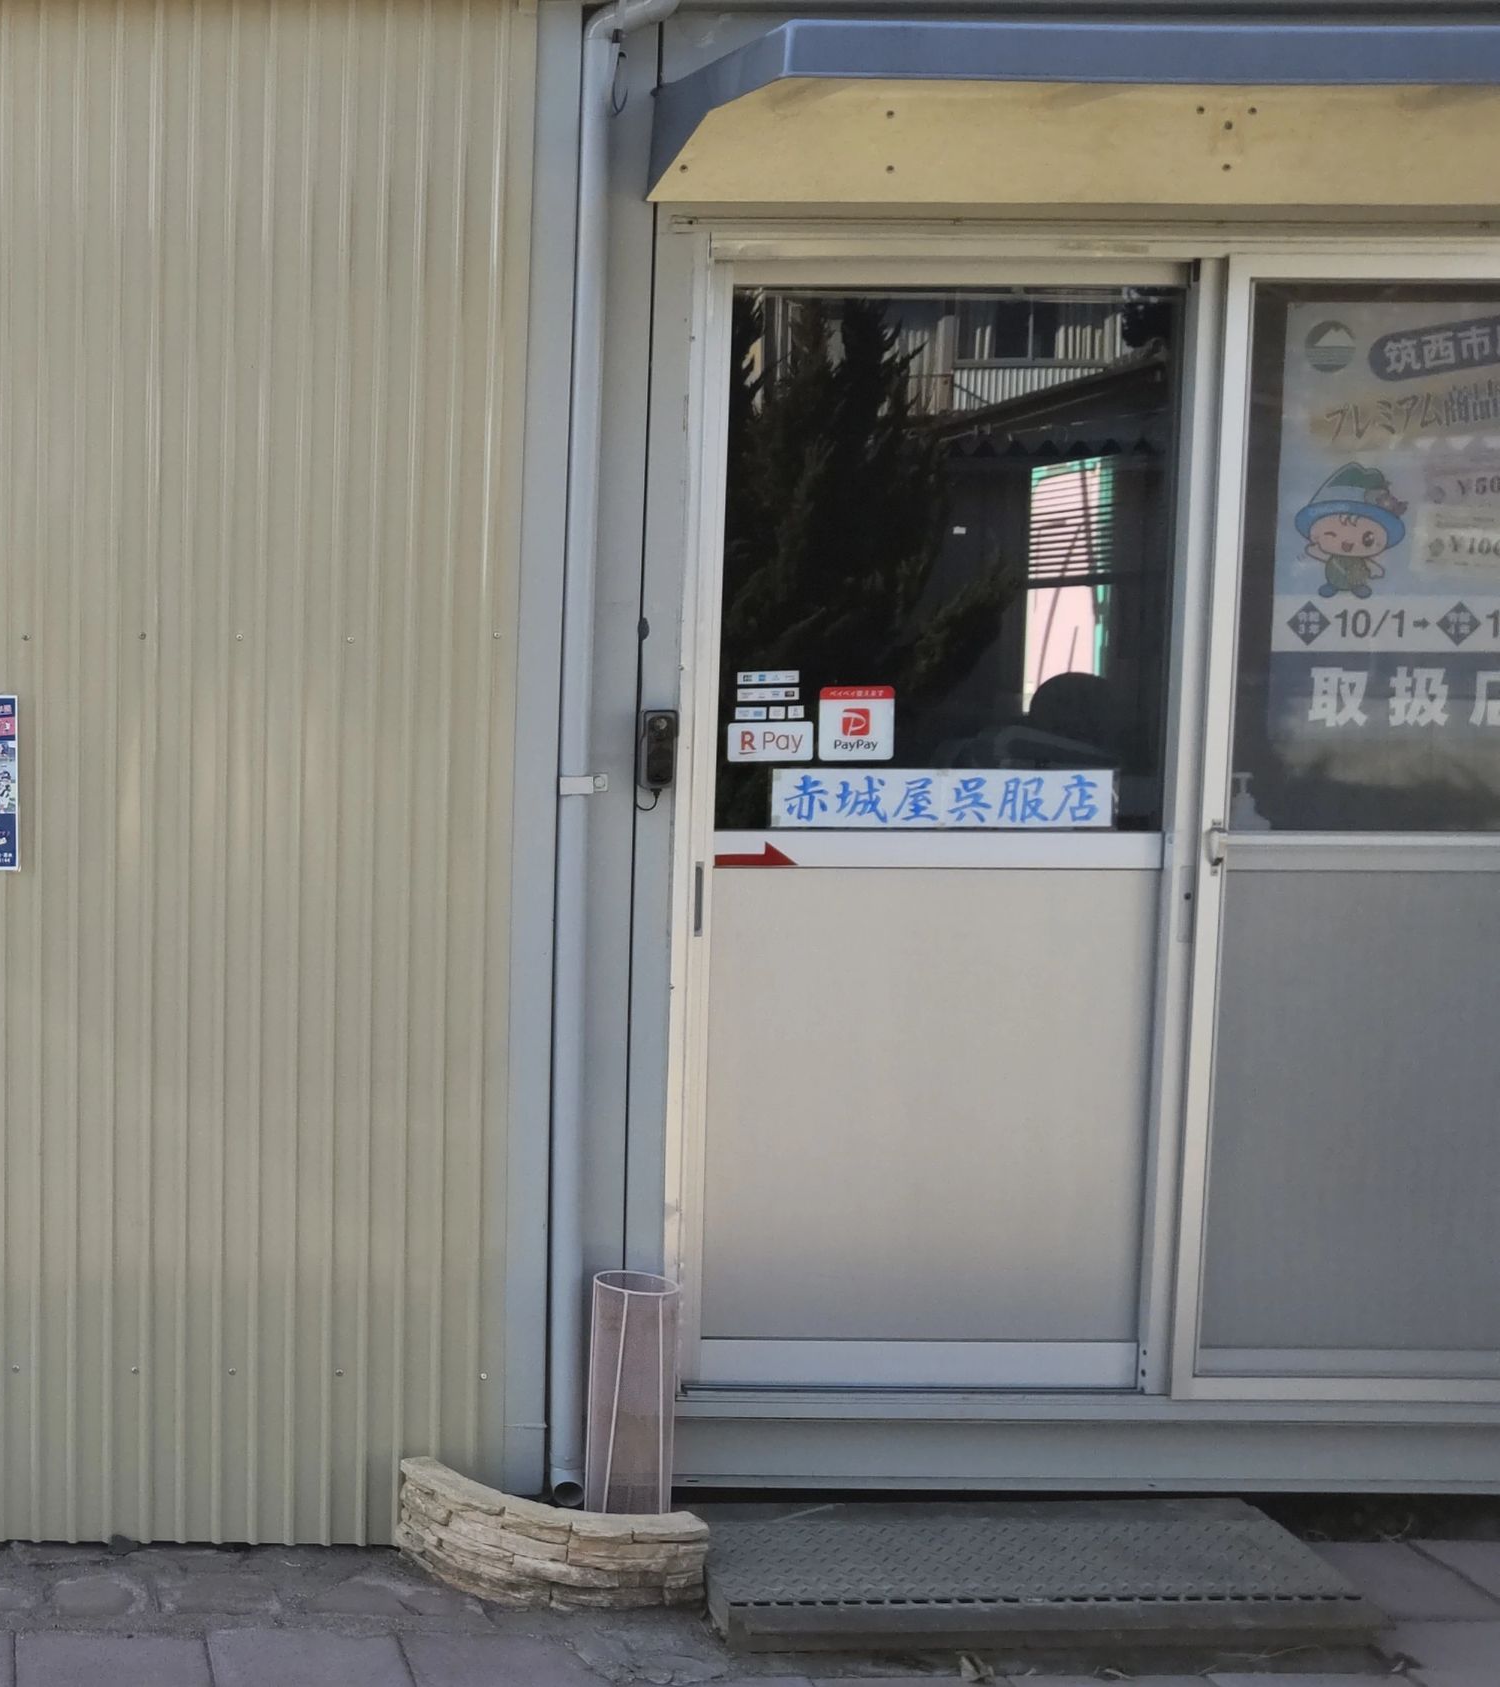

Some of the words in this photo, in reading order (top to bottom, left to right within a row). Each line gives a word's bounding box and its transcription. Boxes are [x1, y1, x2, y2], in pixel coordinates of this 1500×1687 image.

[1383, 325, 1500, 373] 筑西市
[1324, 378, 1500, 441] プレミアム商品
[1334, 609, 1405, 638] 10/1
[763, 731, 803, 754] Pay
[834, 739, 878, 751] PayPay
[784, 774, 1100, 824] 赤城屋呉服店
